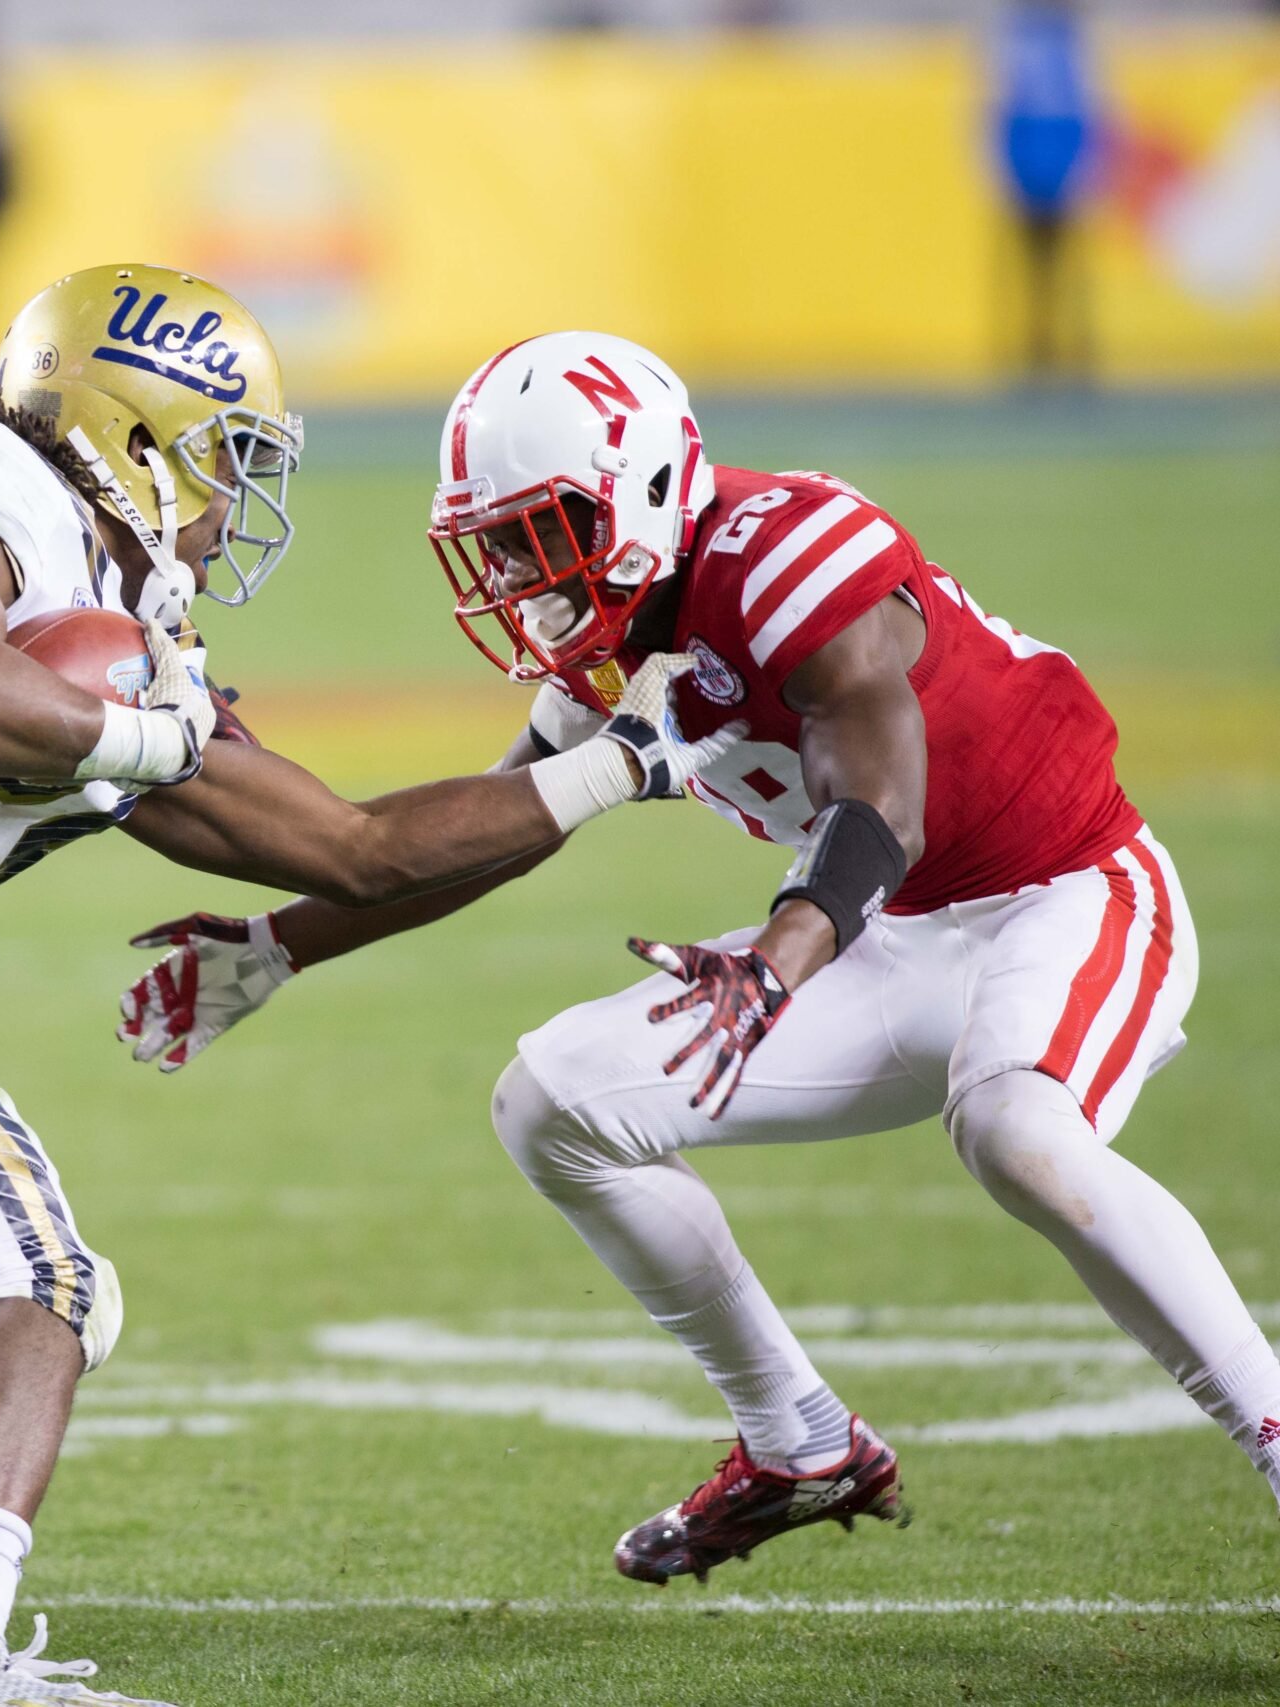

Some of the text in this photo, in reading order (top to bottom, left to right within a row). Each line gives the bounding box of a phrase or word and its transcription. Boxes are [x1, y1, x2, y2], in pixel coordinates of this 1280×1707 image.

[31, 350, 53, 370] 36
[562, 355, 644, 414] N
[787, 1477, 856, 1520] adidas
